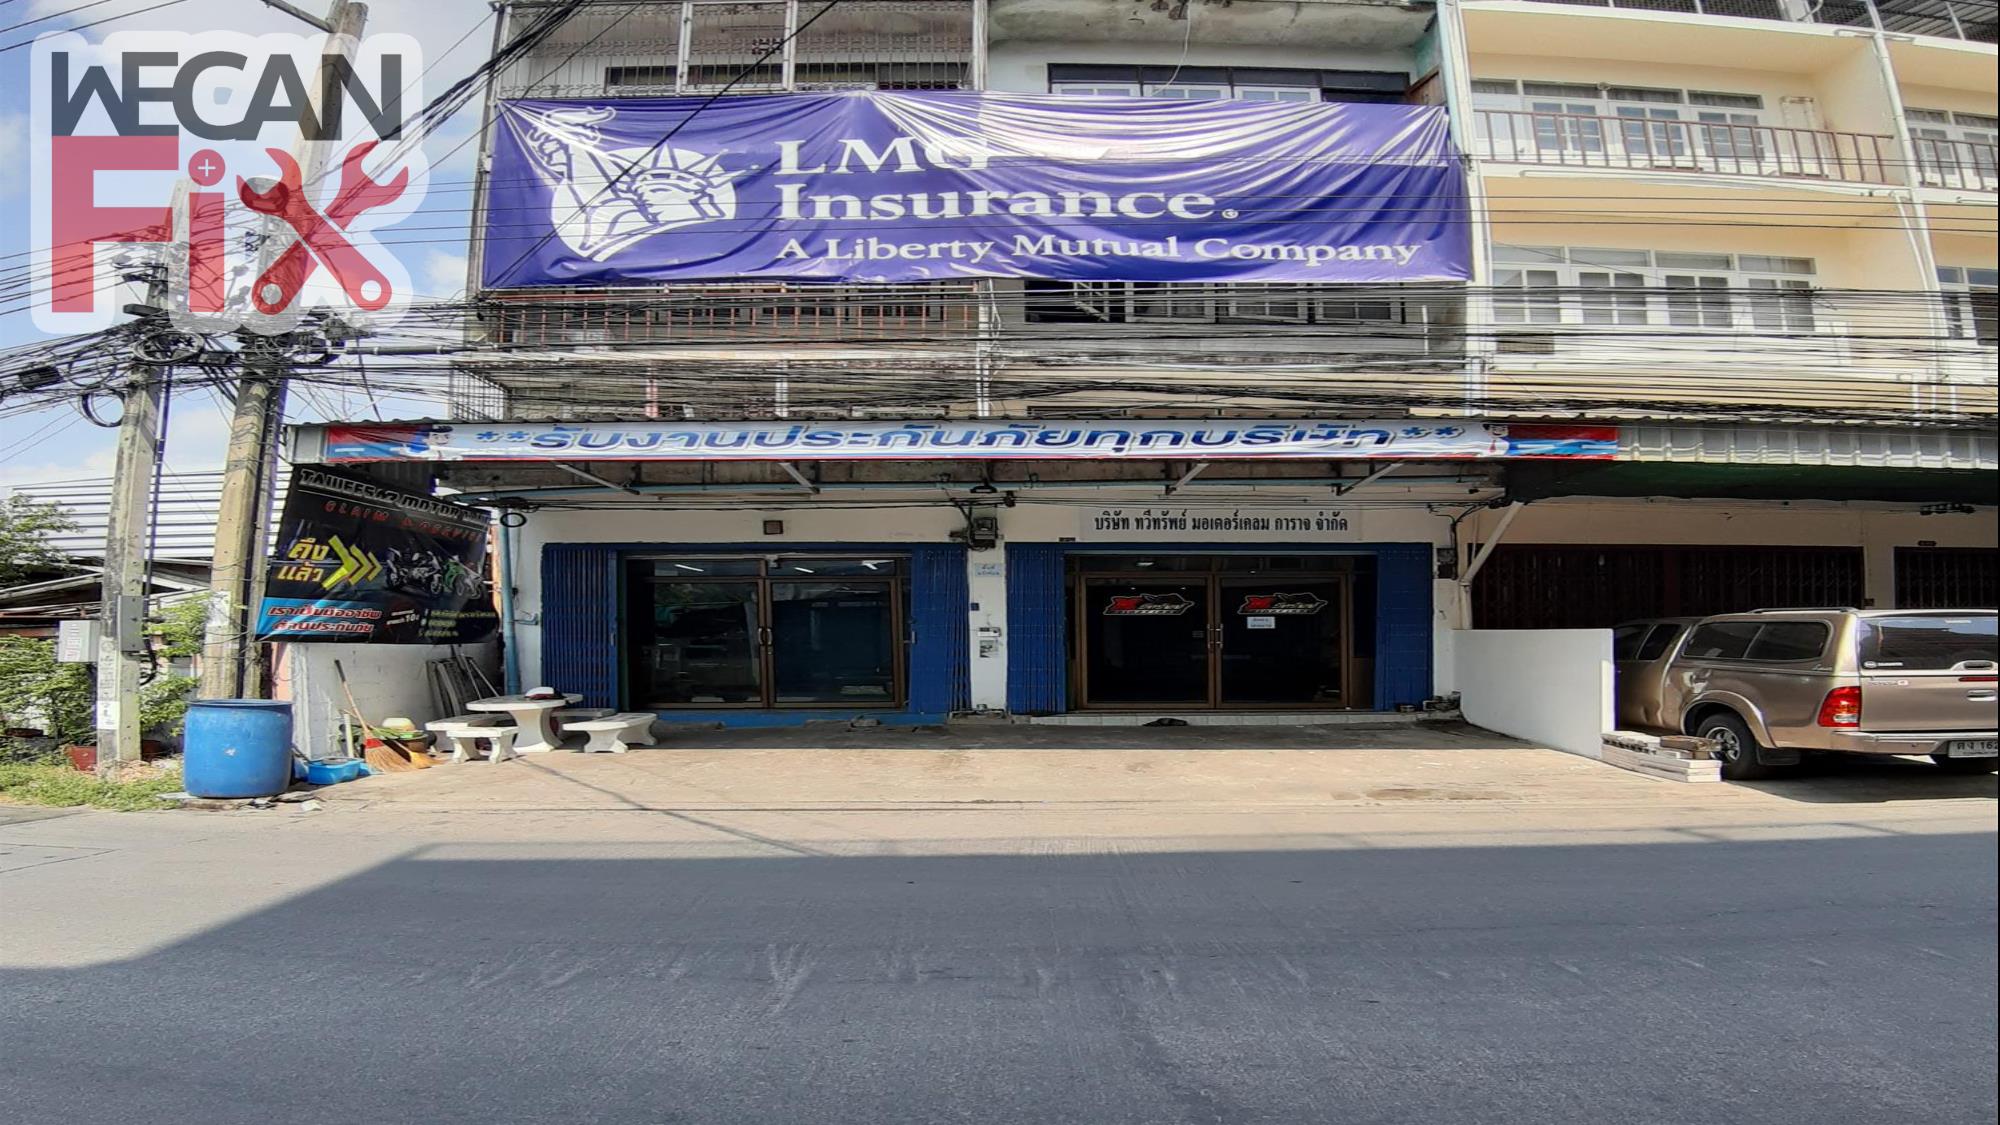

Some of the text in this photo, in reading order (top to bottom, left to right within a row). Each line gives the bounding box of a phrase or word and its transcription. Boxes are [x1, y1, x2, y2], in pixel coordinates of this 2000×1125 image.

[774, 137, 991, 174] LMG
[776, 234, 1421, 266] A Liberty Mutual Company
[1095, 510, 1130, 530] บริษัท
[1135, 509, 1187, 530] ทวีทรัพย์
[1275, 517, 1311, 530] การาจ
[1316, 511, 1348, 531] จำกัด
[277, 561, 325, 582] แล้ว
